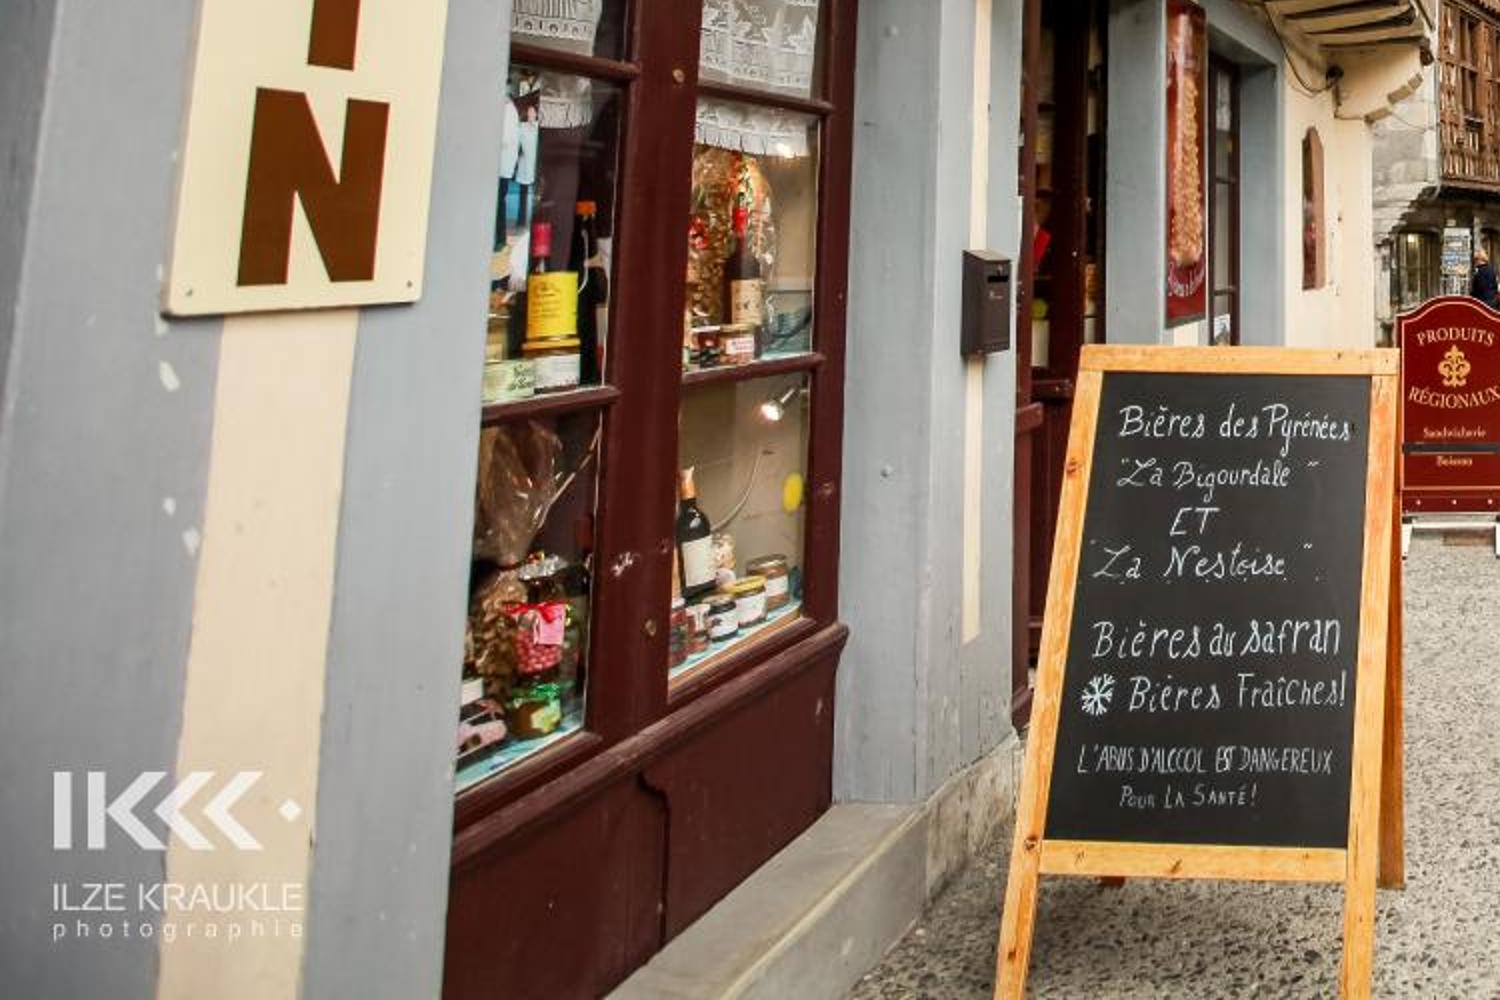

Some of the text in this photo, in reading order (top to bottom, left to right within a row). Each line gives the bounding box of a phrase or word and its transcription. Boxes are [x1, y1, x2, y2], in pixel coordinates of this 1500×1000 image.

[1416, 327, 1496, 347] PRODUITS
[1118, 402, 1351, 457] Bières des Pyrénées
[1169, 506, 1221, 537] ET
[1091, 619, 1201, 659] Bières
[1208, 623, 1237, 657] au
[1128, 674, 1222, 713] Bières
[1238, 746, 1334, 775] DANGEREUX
